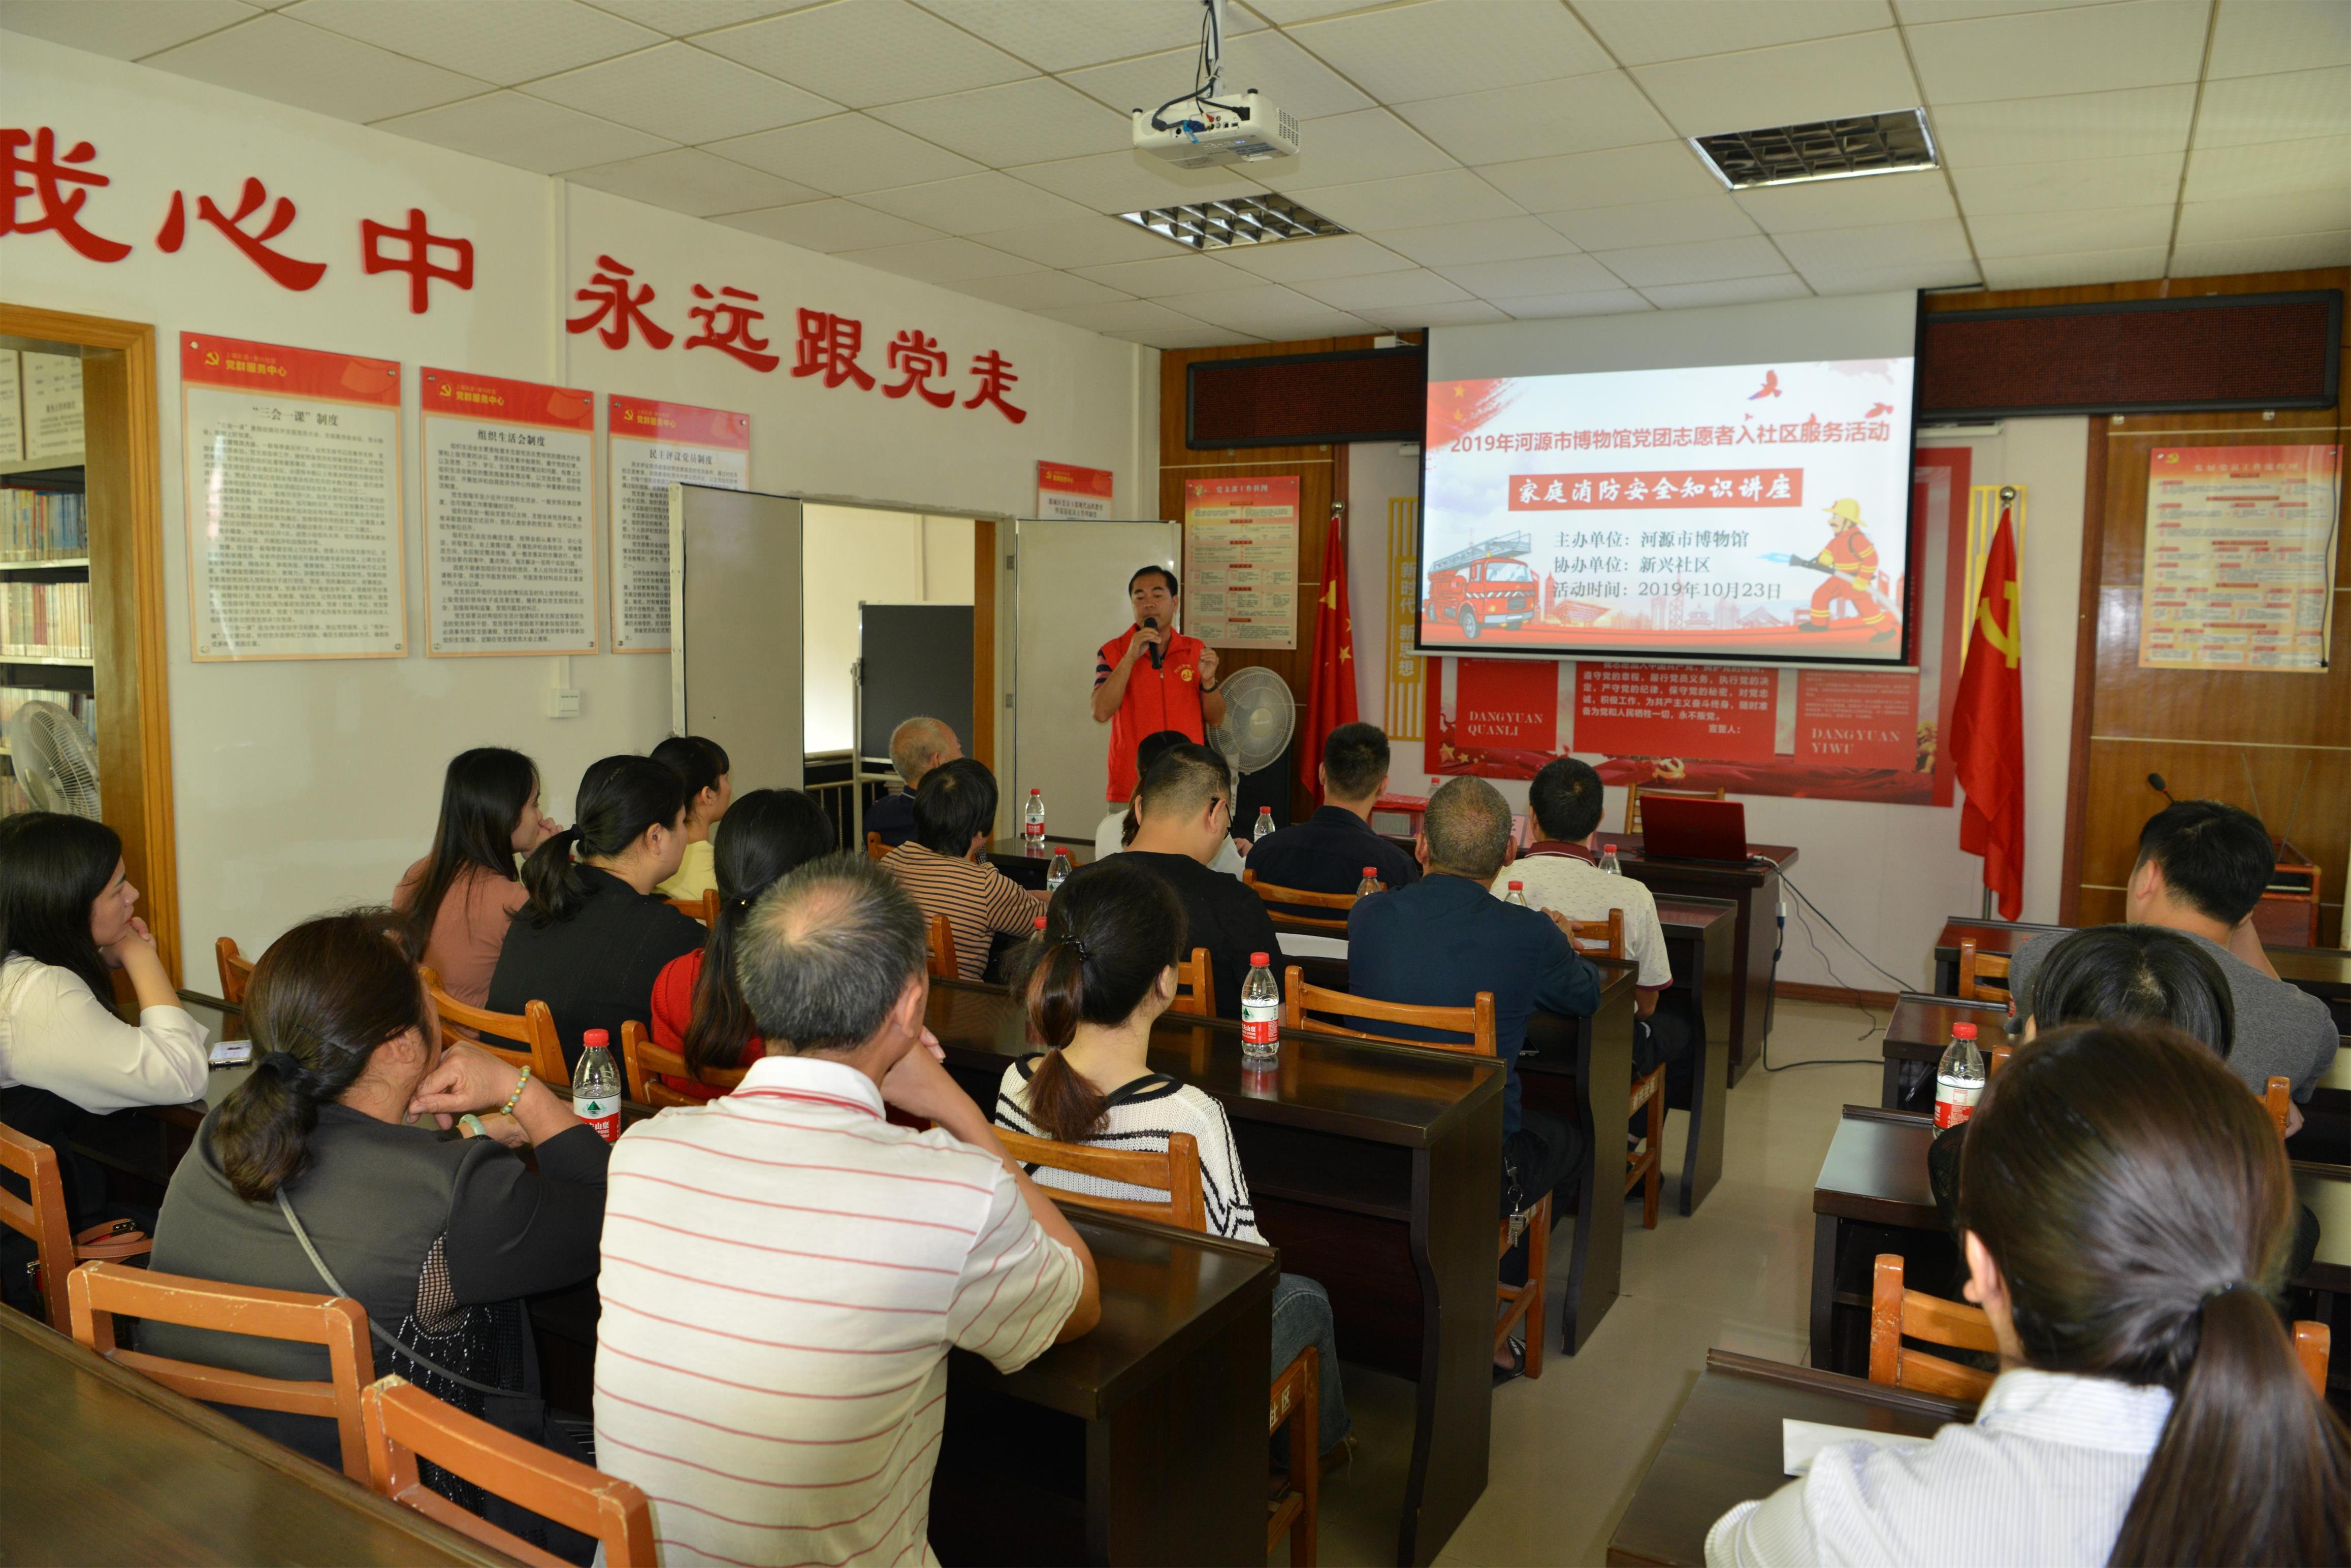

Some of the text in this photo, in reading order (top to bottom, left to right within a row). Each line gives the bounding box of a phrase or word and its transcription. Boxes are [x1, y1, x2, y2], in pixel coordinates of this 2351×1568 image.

[0, 126, 1027, 424] 我心中 永远跟党走
[226, 359, 287, 376] 党群服务中心
[456, 390, 505, 406] 党群服务中心
[477, 430, 545, 447] 组织生活会制度
[1451, 421, 1890, 452] 2019年河源市博物馆党团志愿者入社区服务活动
[650, 449, 713, 464] 民主评议党员制度
[1518, 473, 1792, 504] 家庭消防安全知识讲座
[1554, 531, 1749, 548] 主办单位：河源市博物馆
[1554, 557, 1710, 574] 协办单位：新兴社区
[1553, 581, 1782, 599] 活动时间：2019年10月23日
[1469, 711, 1543, 724] DANGYUAN
[1468, 724, 1519, 736] QUANLI
[1812, 728, 1900, 741] DANGYUAN
[1812, 743, 1854, 755] YIWU
